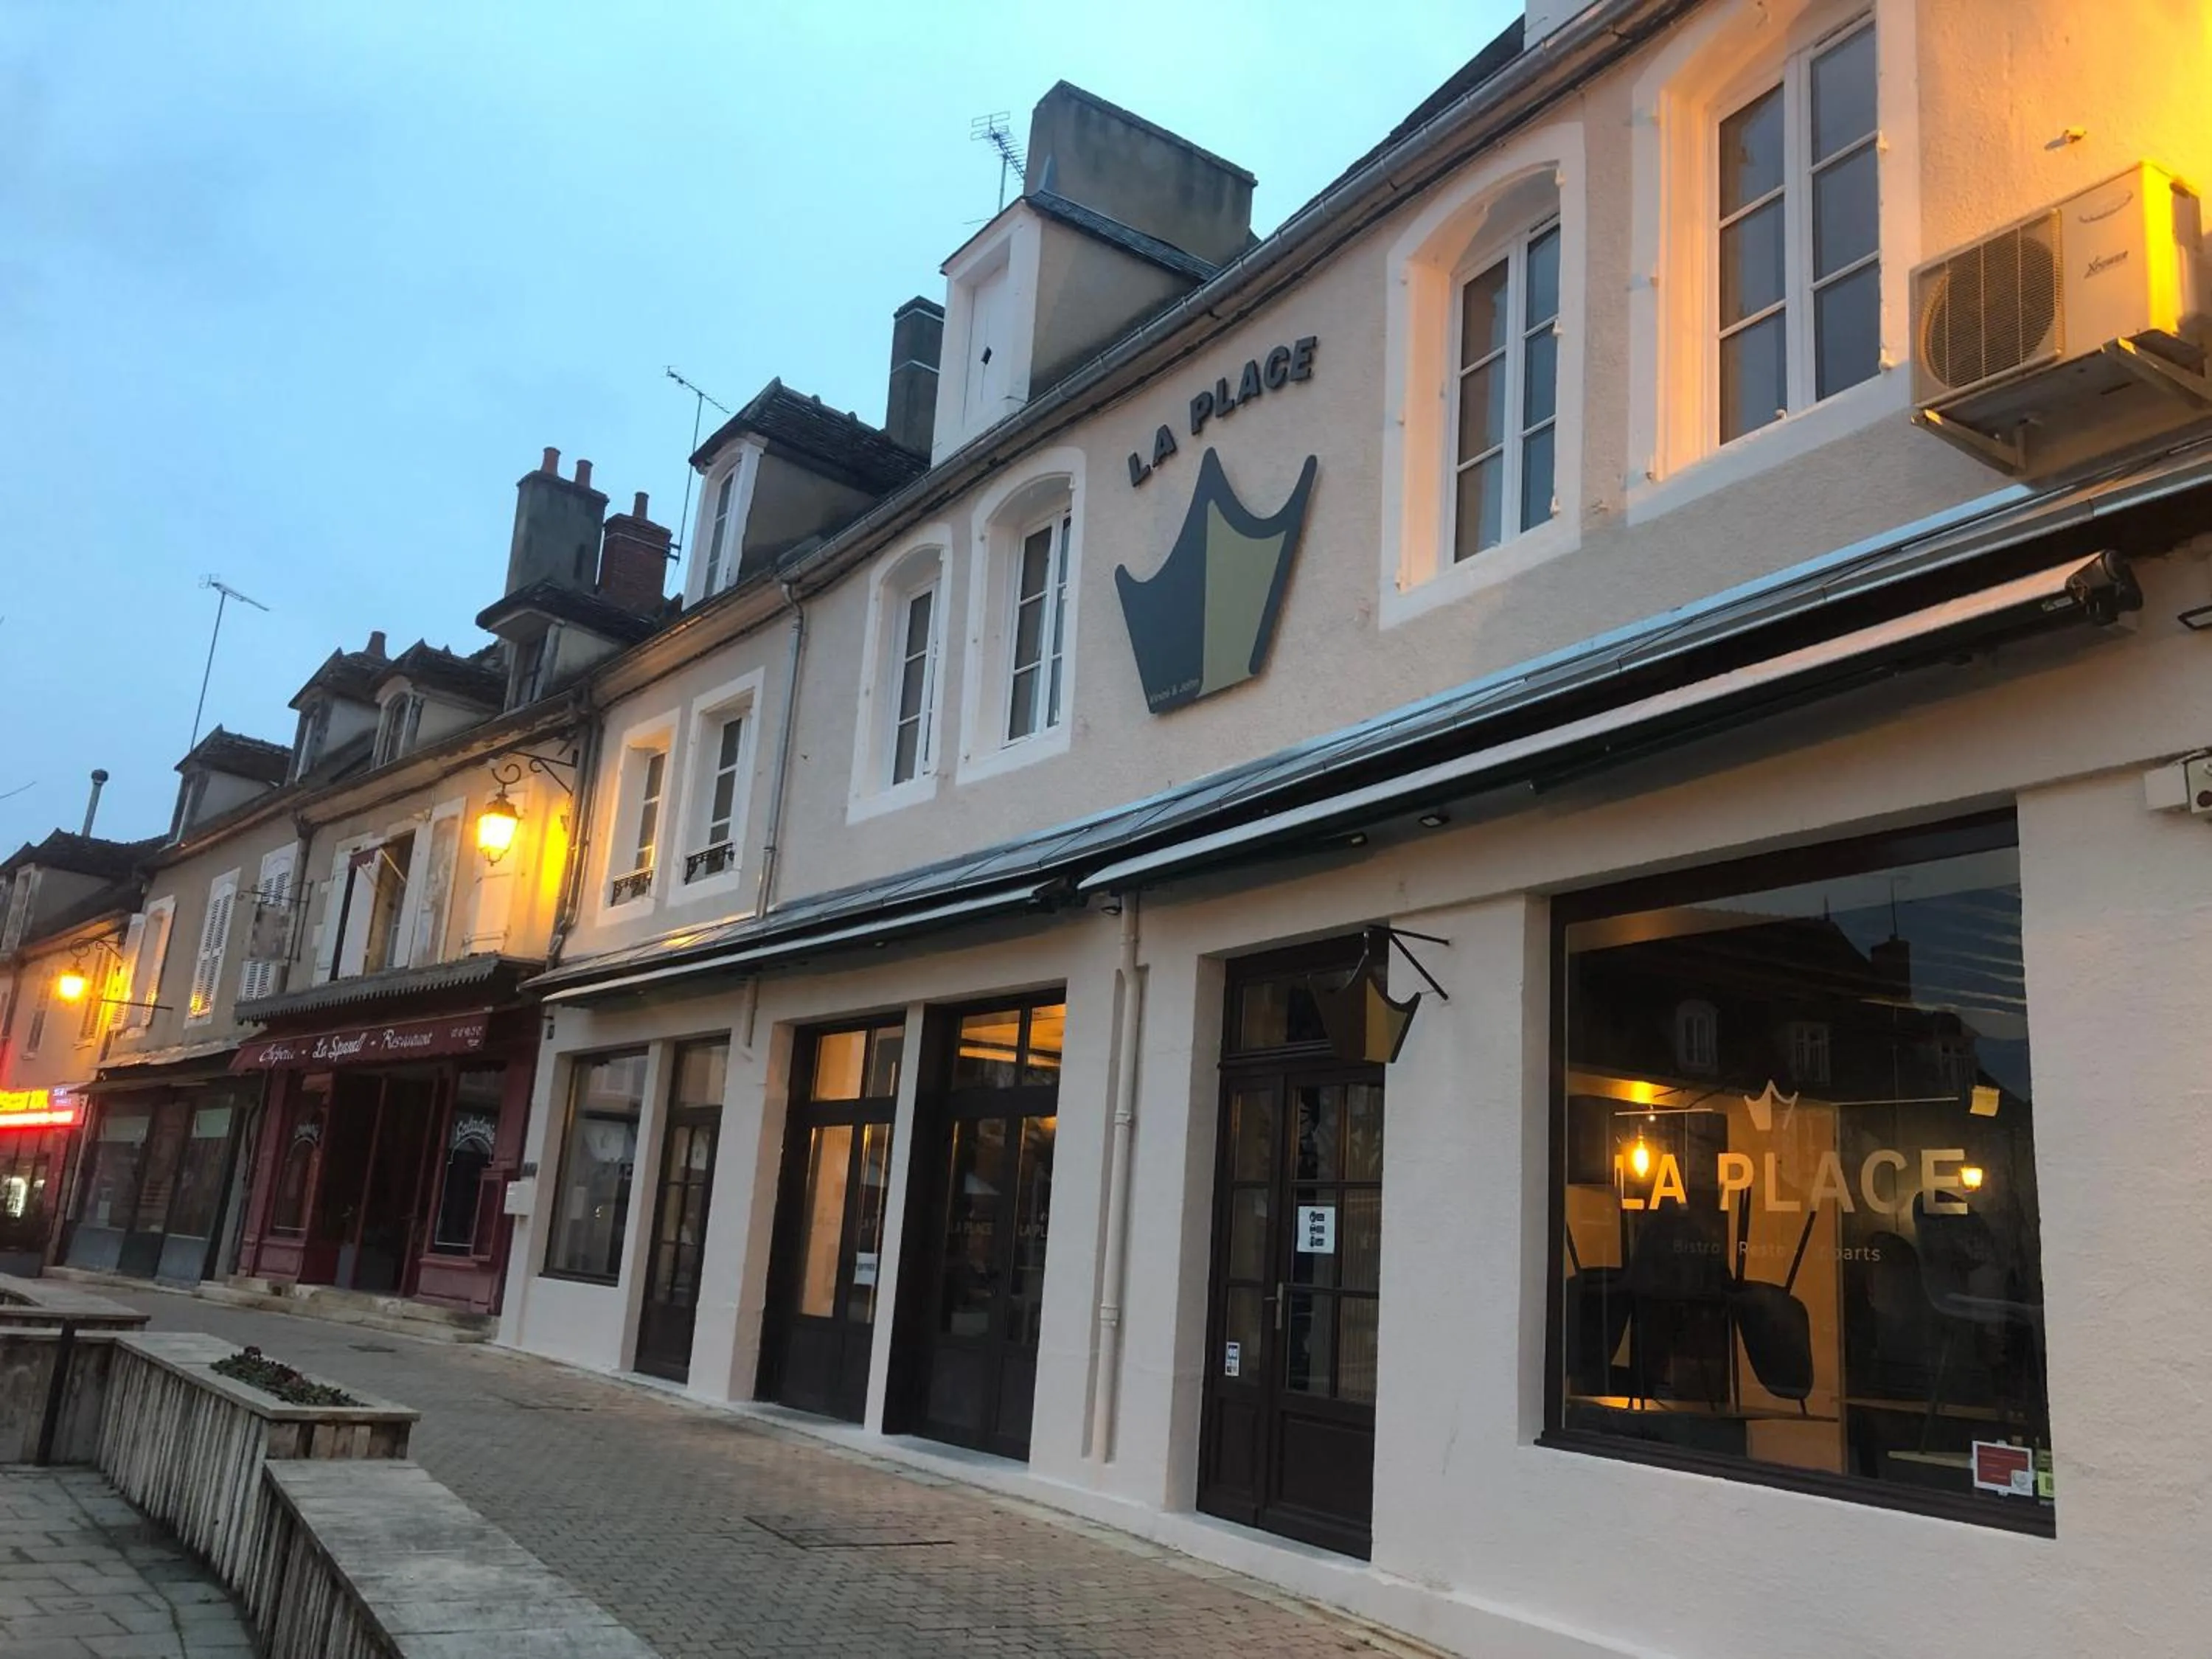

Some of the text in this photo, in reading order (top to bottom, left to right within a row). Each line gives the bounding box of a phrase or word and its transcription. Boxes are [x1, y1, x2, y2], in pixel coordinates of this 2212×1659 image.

[1127, 335, 1318, 487] LA PLACE
[1614, 1148, 1969, 1215] LA PLACE
[1672, 1239, 1721, 1254] Bistro
